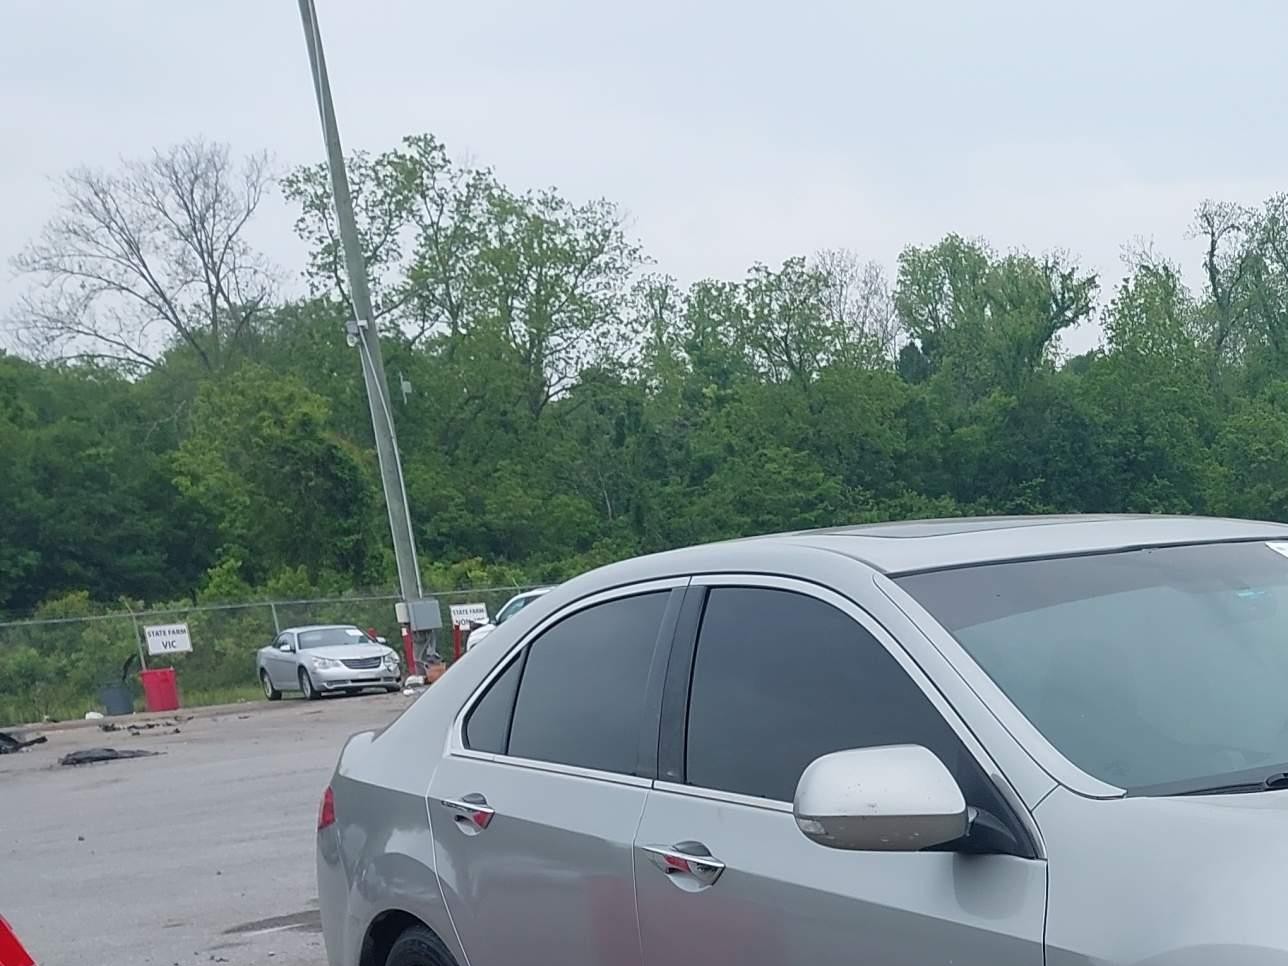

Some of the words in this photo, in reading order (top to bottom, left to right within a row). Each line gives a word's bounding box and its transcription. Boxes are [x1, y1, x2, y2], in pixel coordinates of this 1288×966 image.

[452, 608, 468, 616] STATE
[147, 629, 166, 638] STATE
[167, 628, 186, 636] FARM
[161, 640, 176, 649] VIC
